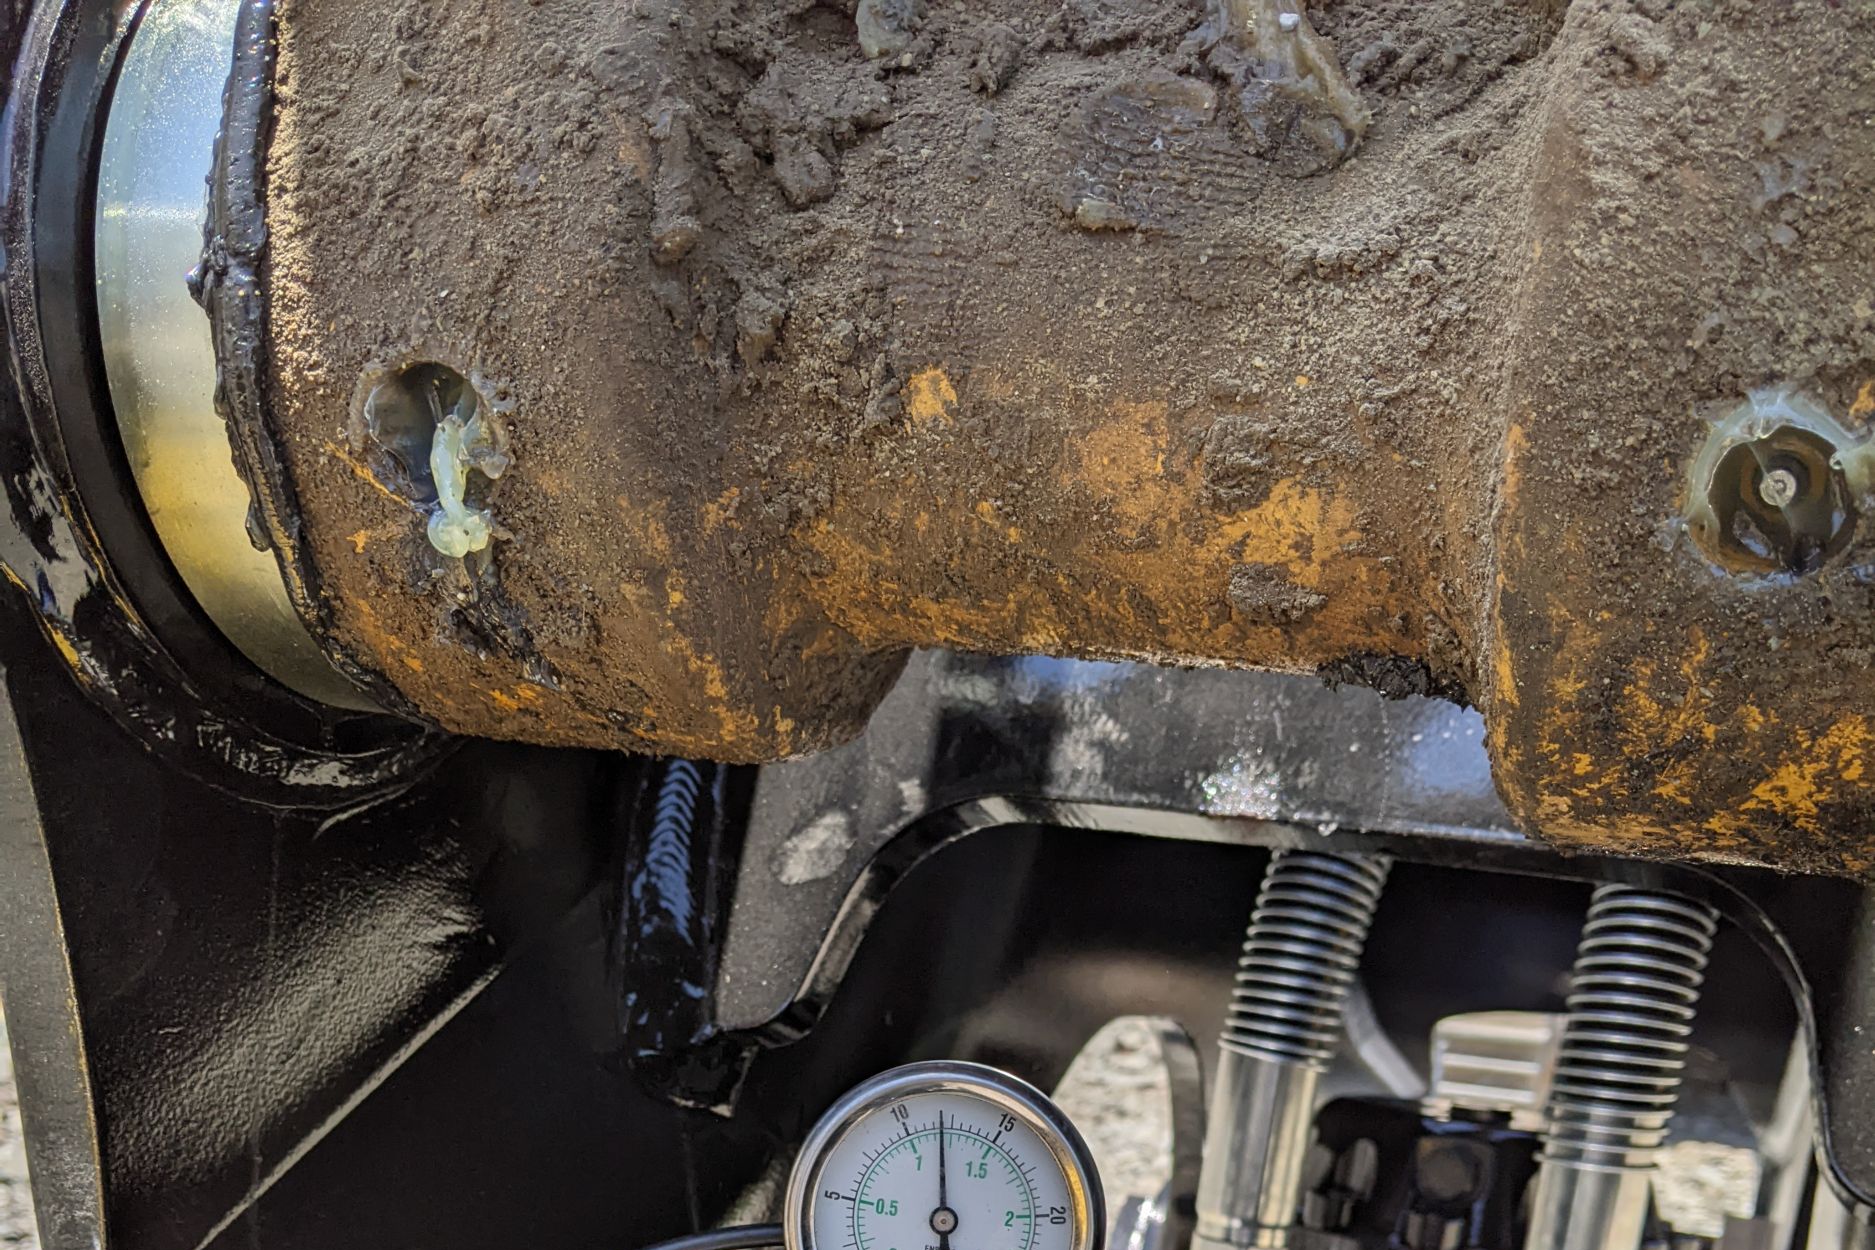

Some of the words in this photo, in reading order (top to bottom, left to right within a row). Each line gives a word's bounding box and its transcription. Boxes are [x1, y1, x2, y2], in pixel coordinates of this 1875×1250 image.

[890, 1104, 909, 1122] 10
[998, 1113, 1017, 1133] 15
[915, 1156, 922, 1171] 1
[965, 1160, 988, 1179] 1.5
[824, 1190, 841, 1201] 5
[875, 1198, 898, 1216] 0.5
[1050, 1206, 1067, 1225] 20
[1005, 1211, 1013, 1227] 2
